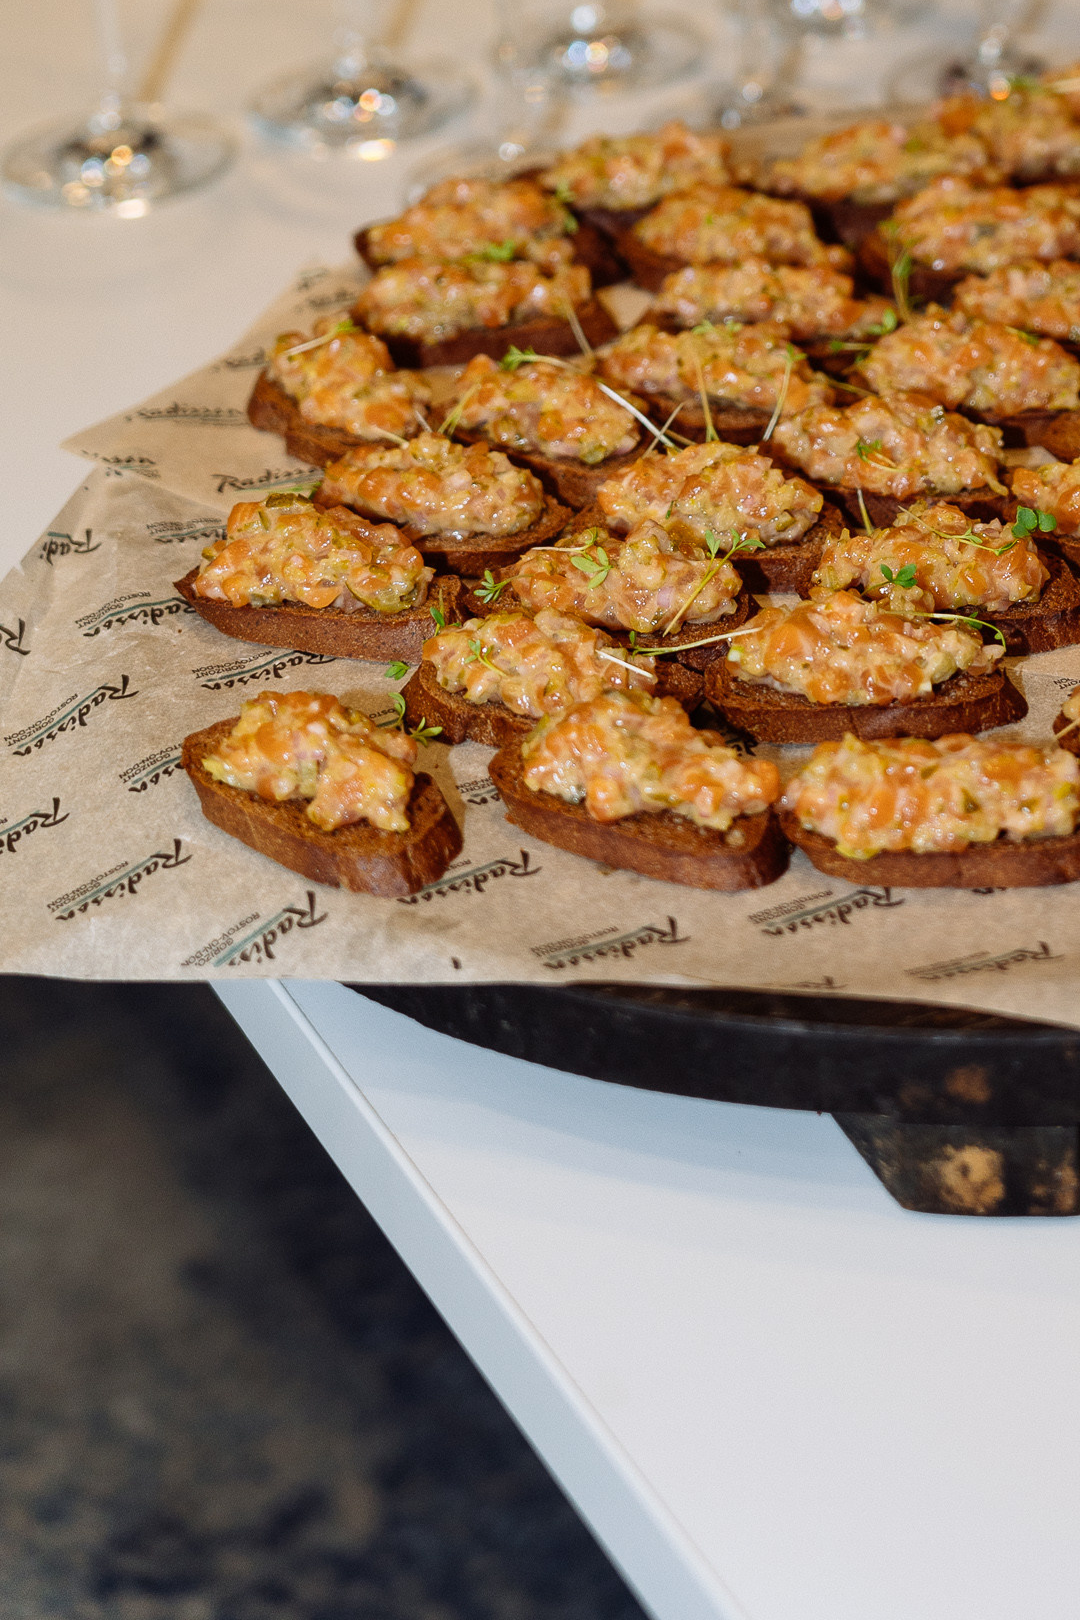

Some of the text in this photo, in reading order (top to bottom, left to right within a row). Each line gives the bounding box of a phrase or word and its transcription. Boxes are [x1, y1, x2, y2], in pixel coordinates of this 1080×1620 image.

[38, 529, 102, 565] Radi
[74, 590, 151, 624] ROSTOV-ON-DON
[77, 602, 125, 628] GORIZONT
[190, 650, 272, 675] ROSTOV-ON-DON
[193, 663, 246, 680] GORIZONT
[3, 693, 79, 742] ROSTOV-ON-DON
[7, 717, 55, 747] GORIZONT
[12, 674, 140, 757] Radisson
[118, 743, 182, 780] STOV-ON-DON
[122, 753, 171, 784] GORIZONT
[46, 860, 129, 909] ROSTOV-ON-DON
[54, 838, 194, 921] Radisson
[396, 850, 542, 905] Radisson
[50, 881, 101, 914] GORIZONT
[762, 887, 905, 937] Radisson
[194, 937, 235, 967] GORIZO
[542, 915, 692, 970] Radisson
